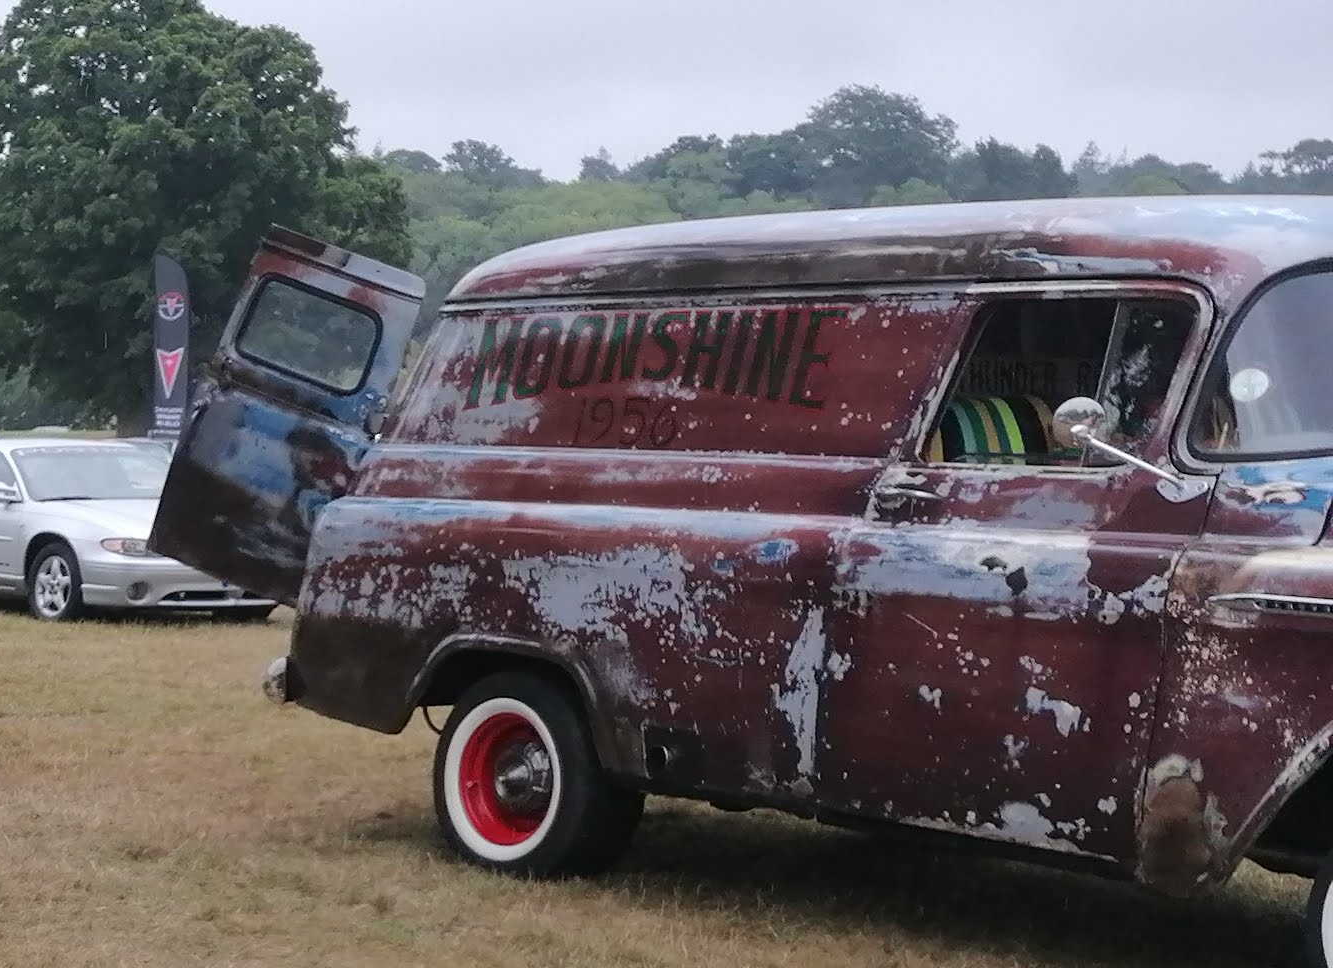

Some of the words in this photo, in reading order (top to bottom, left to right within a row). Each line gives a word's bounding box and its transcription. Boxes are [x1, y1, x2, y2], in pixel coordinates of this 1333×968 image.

[462, 303, 855, 411] MOONSHINE
[958, 360, 1058, 396] HUNDER
[572, 396, 678, 447] 1956
